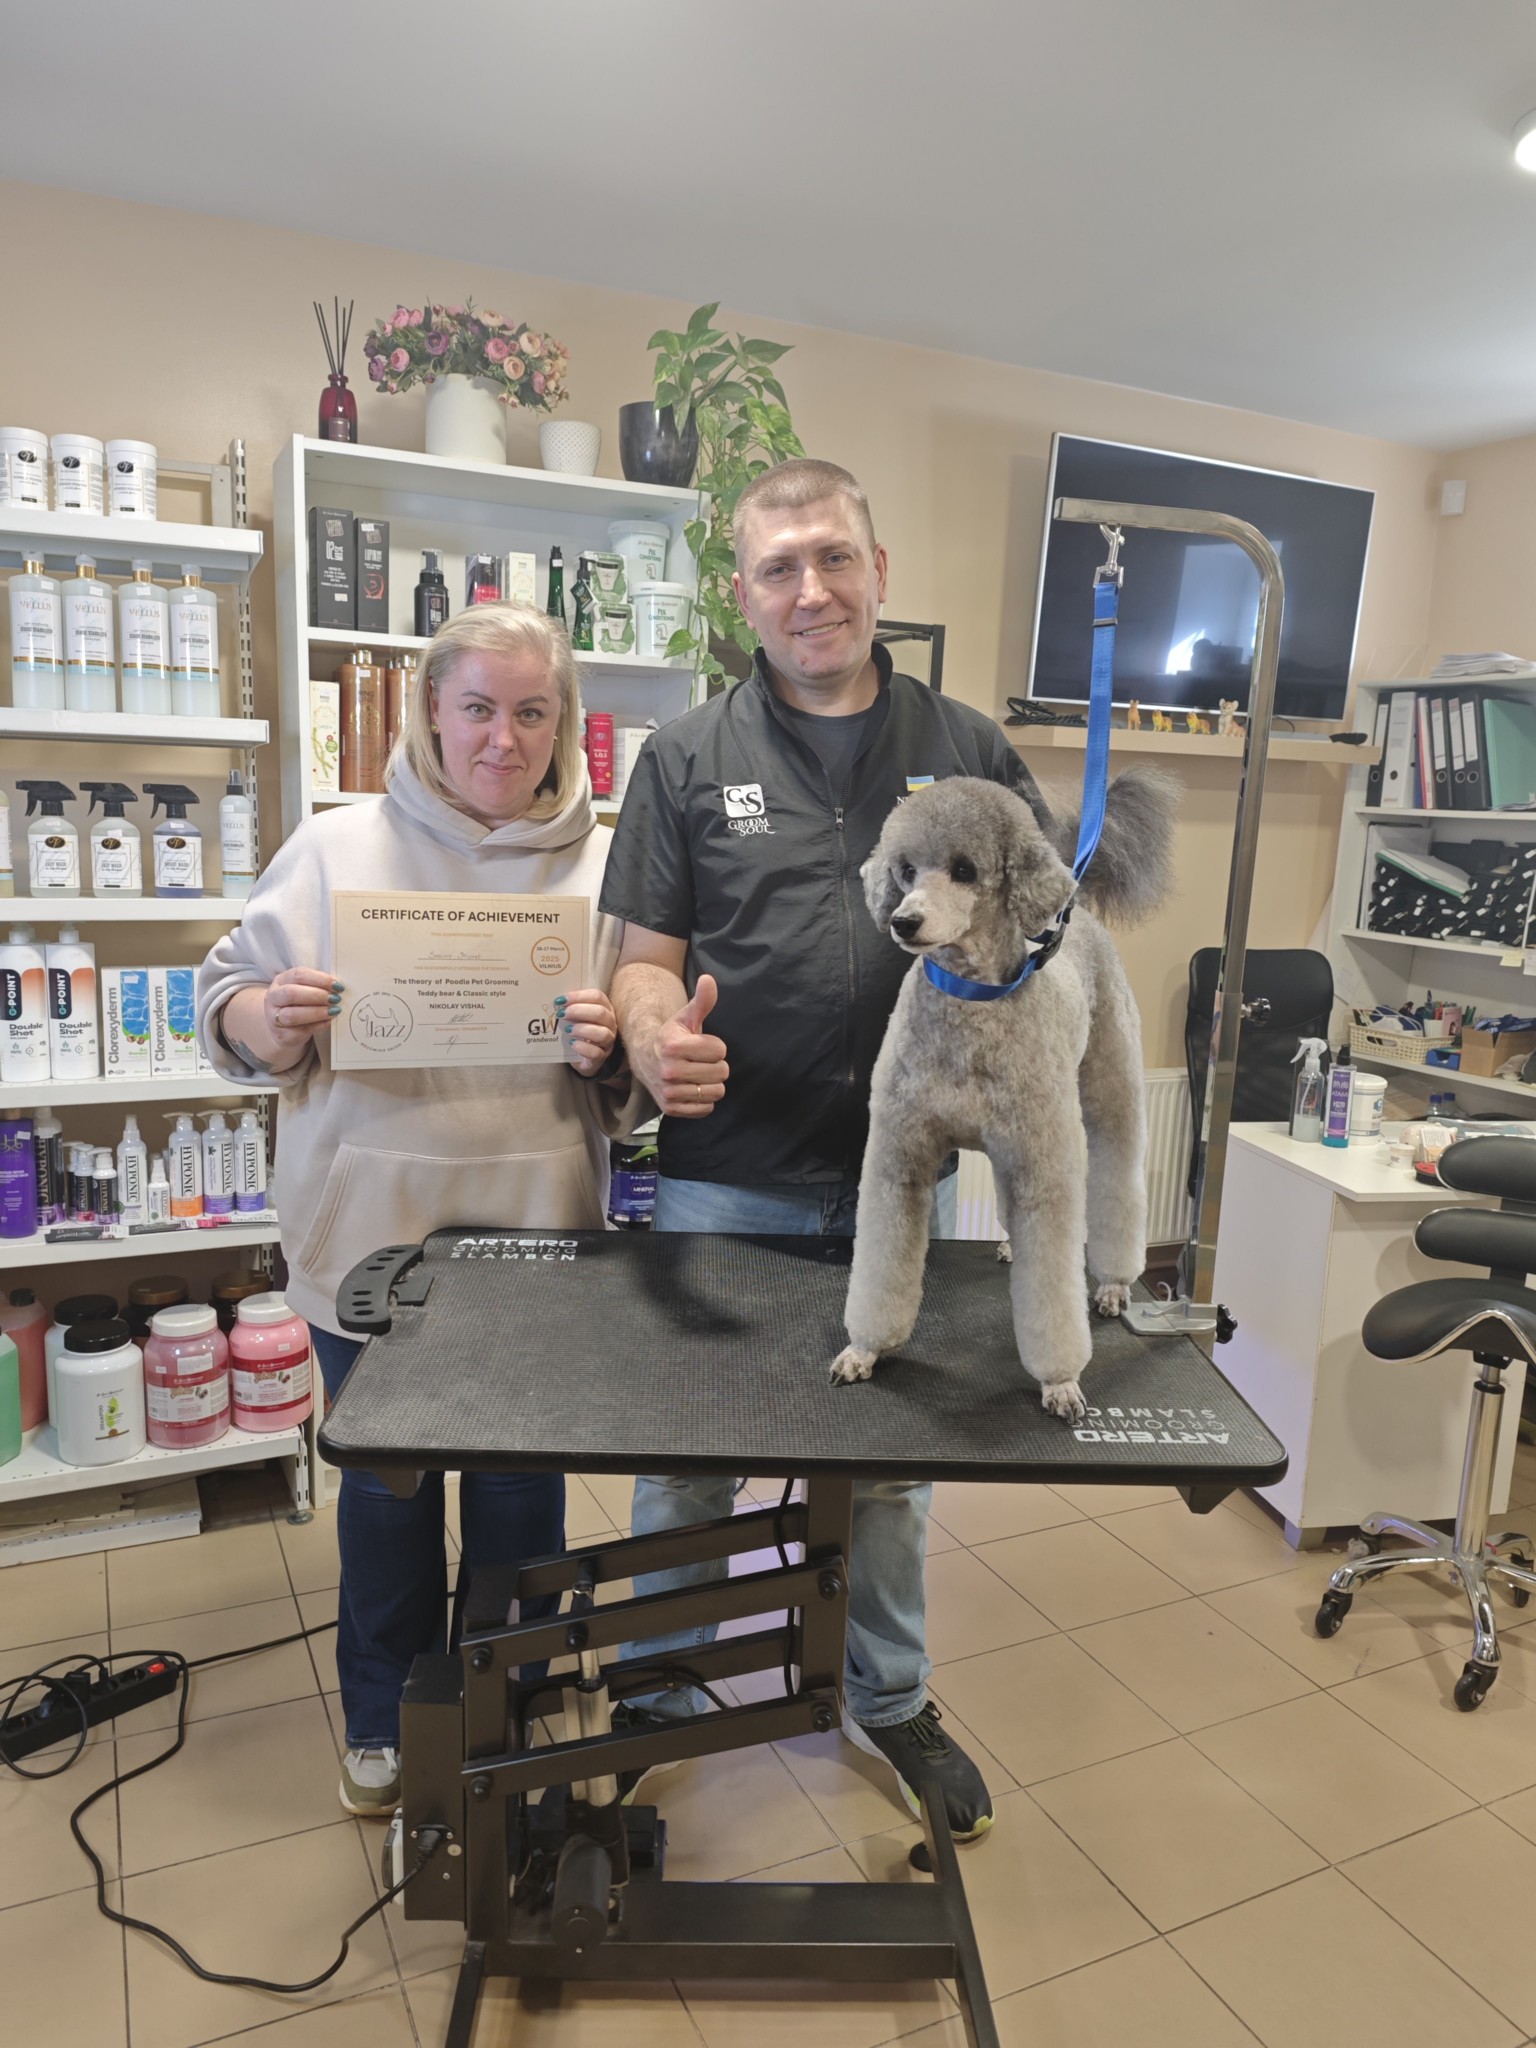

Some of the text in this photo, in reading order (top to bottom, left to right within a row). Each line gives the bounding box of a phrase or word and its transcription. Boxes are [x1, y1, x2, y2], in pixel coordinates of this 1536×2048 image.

[728, 817, 771, 830] GROOM
[739, 826, 775, 837] SOUL
[361, 908, 560, 923] CERTIFICATE OF ACHIEVEMENT
[408, 978, 432, 986] theory
[484, 978, 519, 987] Grooming
[417, 990, 437, 998] Teddy
[490, 990, 506, 998] style
[59, 1021, 93, 1029] Double
[107, 987, 120, 1064] Clorexyderm
[153, 986, 166, 1062] Clorexyderm
[365, 1021, 406, 1038] Jazz
[182, 1146, 194, 1197] HYPONIC
[223, 1142, 233, 1193] HYPONIC
[246, 1142, 256, 1192] HYPONIC
[127, 1155, 138, 1201] HYPONIC
[457, 1238, 578, 1247] ARTERO
[453, 1246, 576, 1254] GROOMING
[1073, 1430, 1230, 1444] ARTERO
